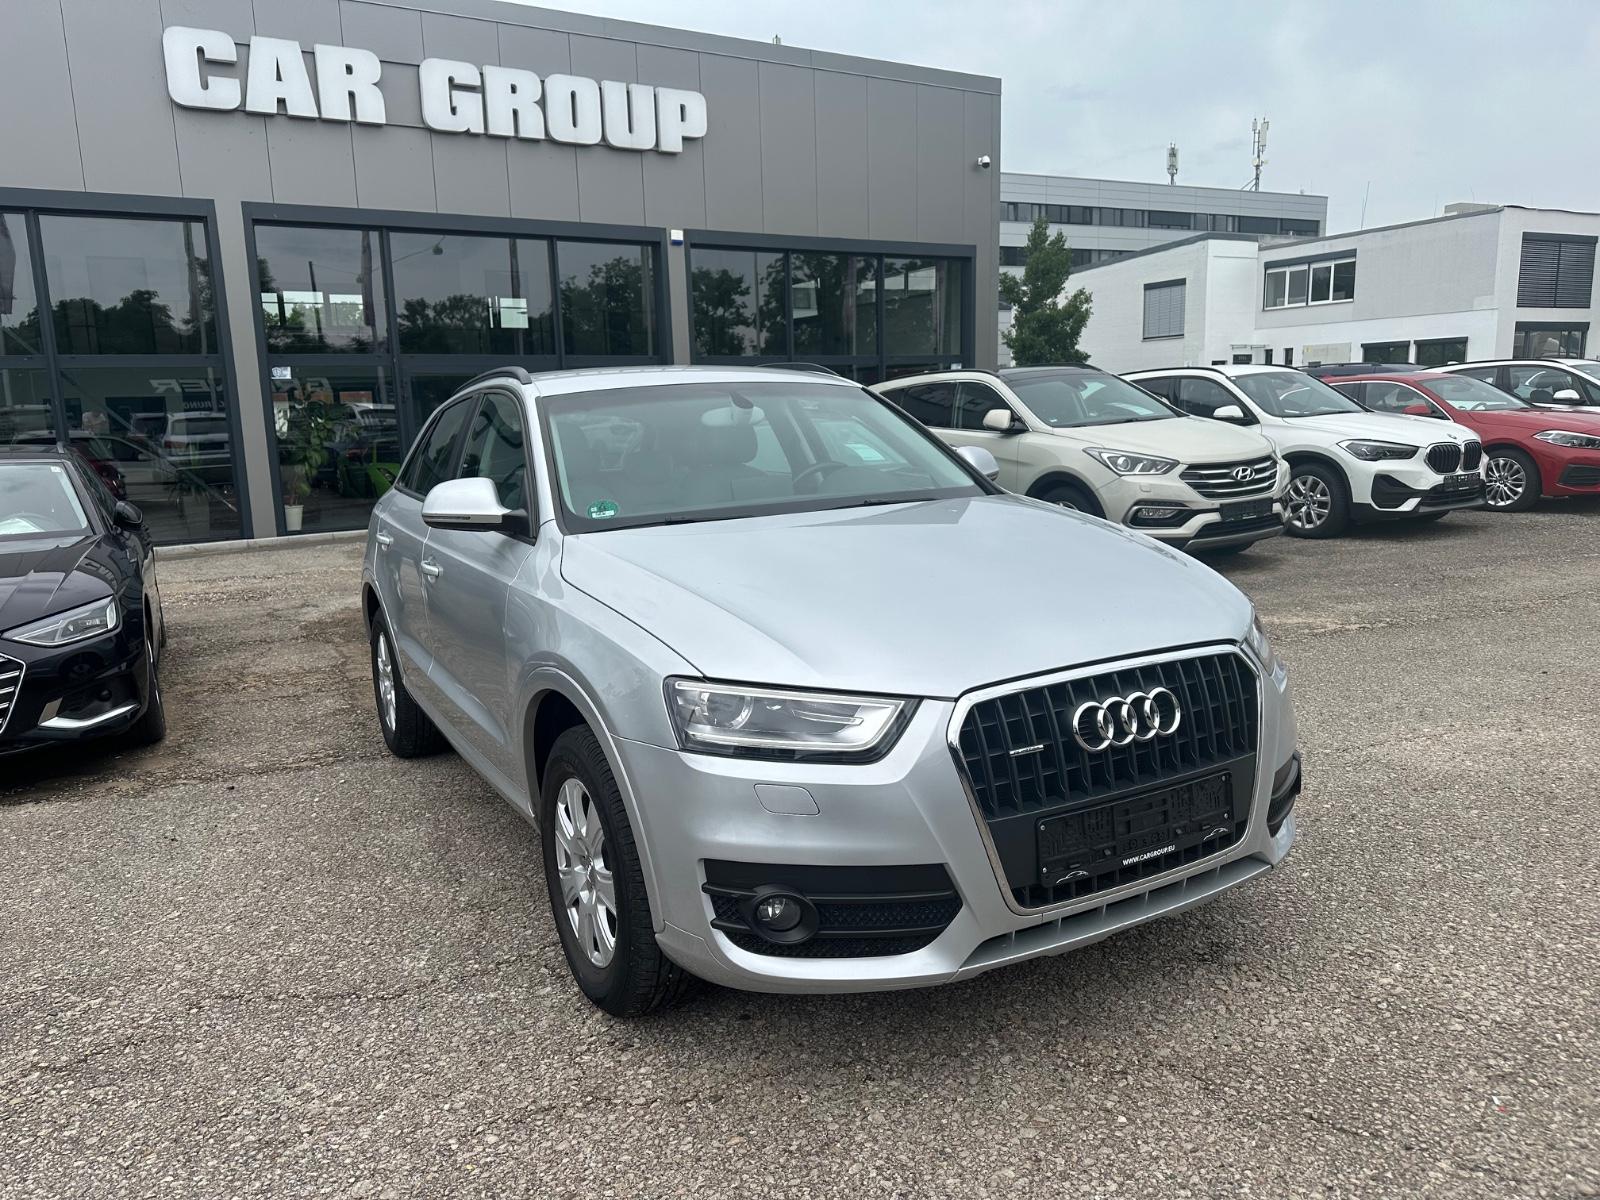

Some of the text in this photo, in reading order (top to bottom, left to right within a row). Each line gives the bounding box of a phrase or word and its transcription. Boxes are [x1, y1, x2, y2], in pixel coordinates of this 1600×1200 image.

[162, 25, 708, 155] CAR GROUP
[1122, 845, 1176, 866] WWW.CARGROUP.EU
